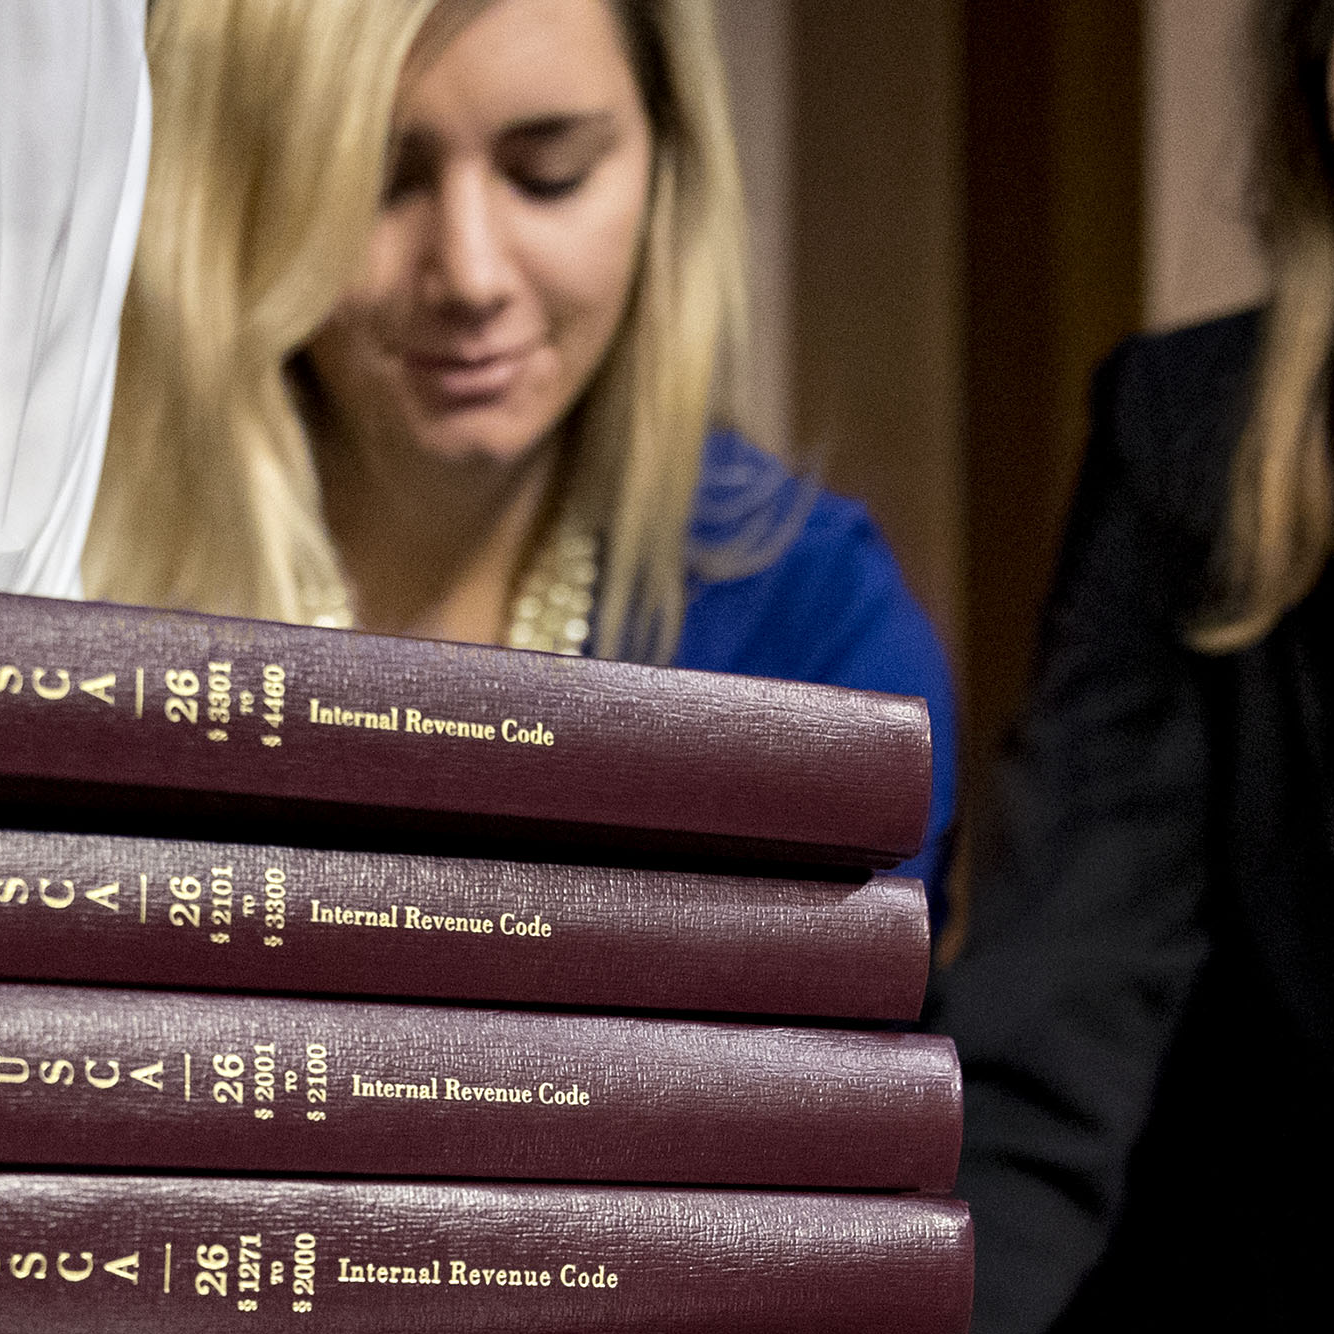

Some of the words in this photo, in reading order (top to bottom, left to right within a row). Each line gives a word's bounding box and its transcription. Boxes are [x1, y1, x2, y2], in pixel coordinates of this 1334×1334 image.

[164, 668, 201, 725] 26
[309, 697, 400, 732] Internal
[404, 706, 496, 741] Revenue
[500, 718, 555, 747] Code
[168, 874, 203, 928] 26
[309, 898, 398, 929] Internal
[403, 905, 495, 935] Revenue
[498, 911, 552, 938] Code
[211, 1053, 246, 1104] 26
[352, 1073, 438, 1100] Internal
[444, 1077, 532, 1103] Revenue
[537, 1083, 588, 1107] Code
[194, 1243, 230, 1297] 26
[336, 1256, 442, 1285] Internal
[447, 1259, 553, 1287] Revenue
[559, 1263, 619, 1289] Code
